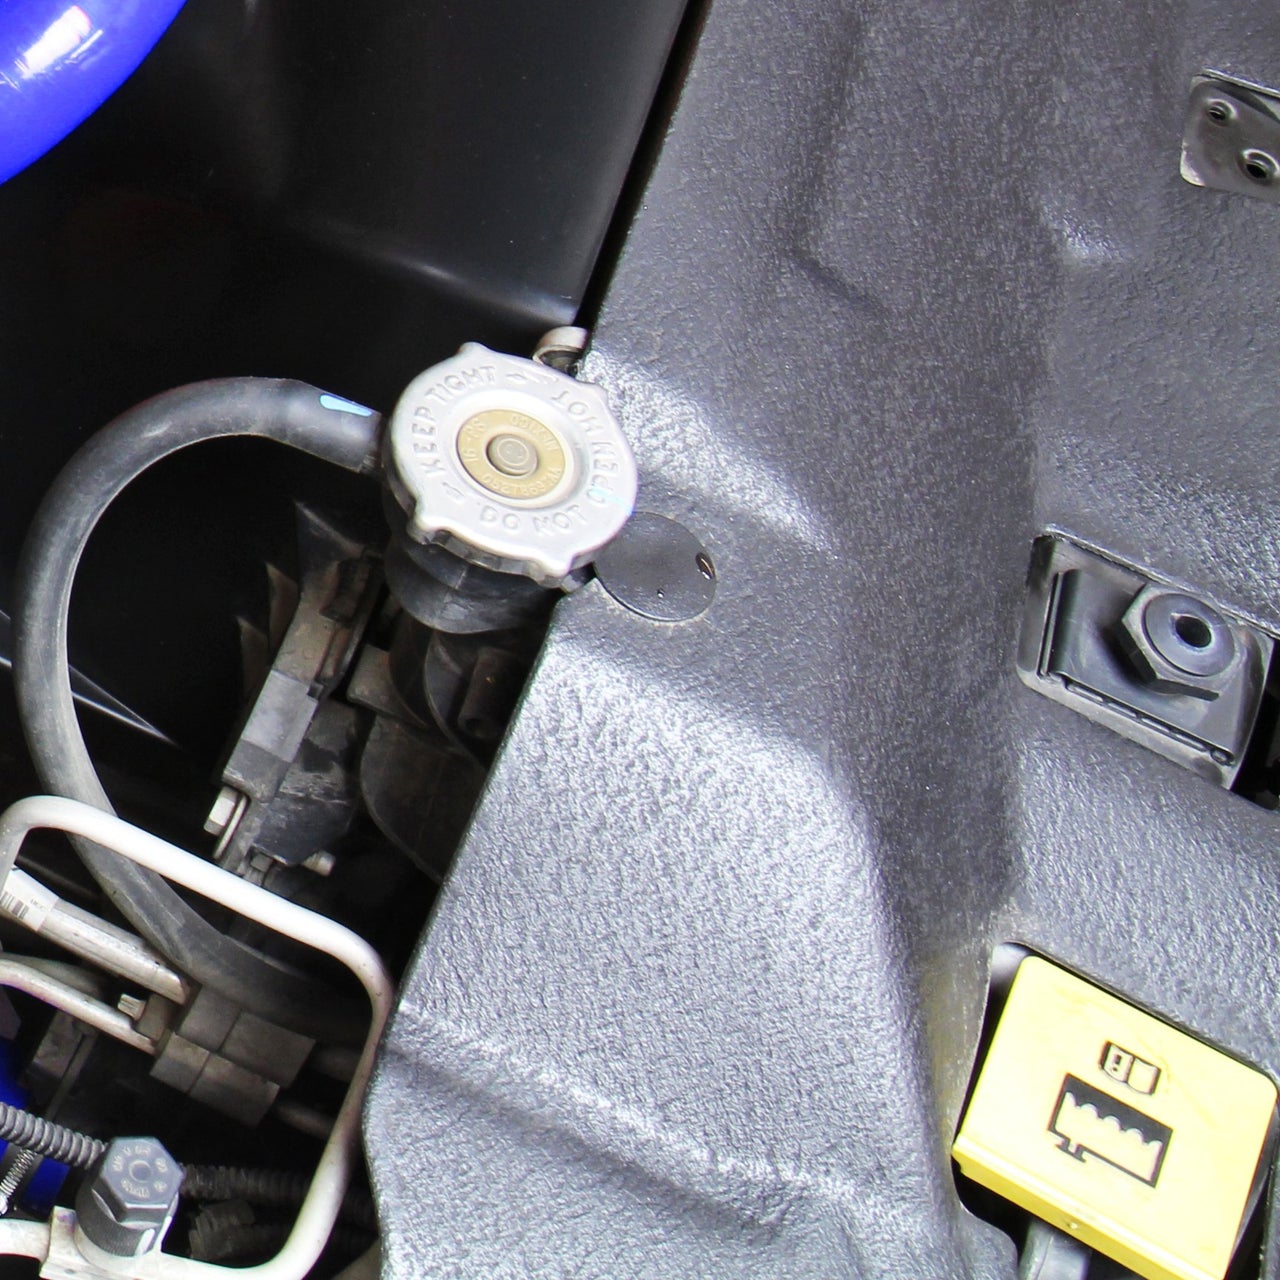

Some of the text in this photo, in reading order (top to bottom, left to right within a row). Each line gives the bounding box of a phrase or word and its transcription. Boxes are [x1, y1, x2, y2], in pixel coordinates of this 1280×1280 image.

[426, 366, 496, 405] TIGHT
[412, 407, 446, 475] KEEP
[479, 389, 620, 537] DO NOT OPEN HOT
